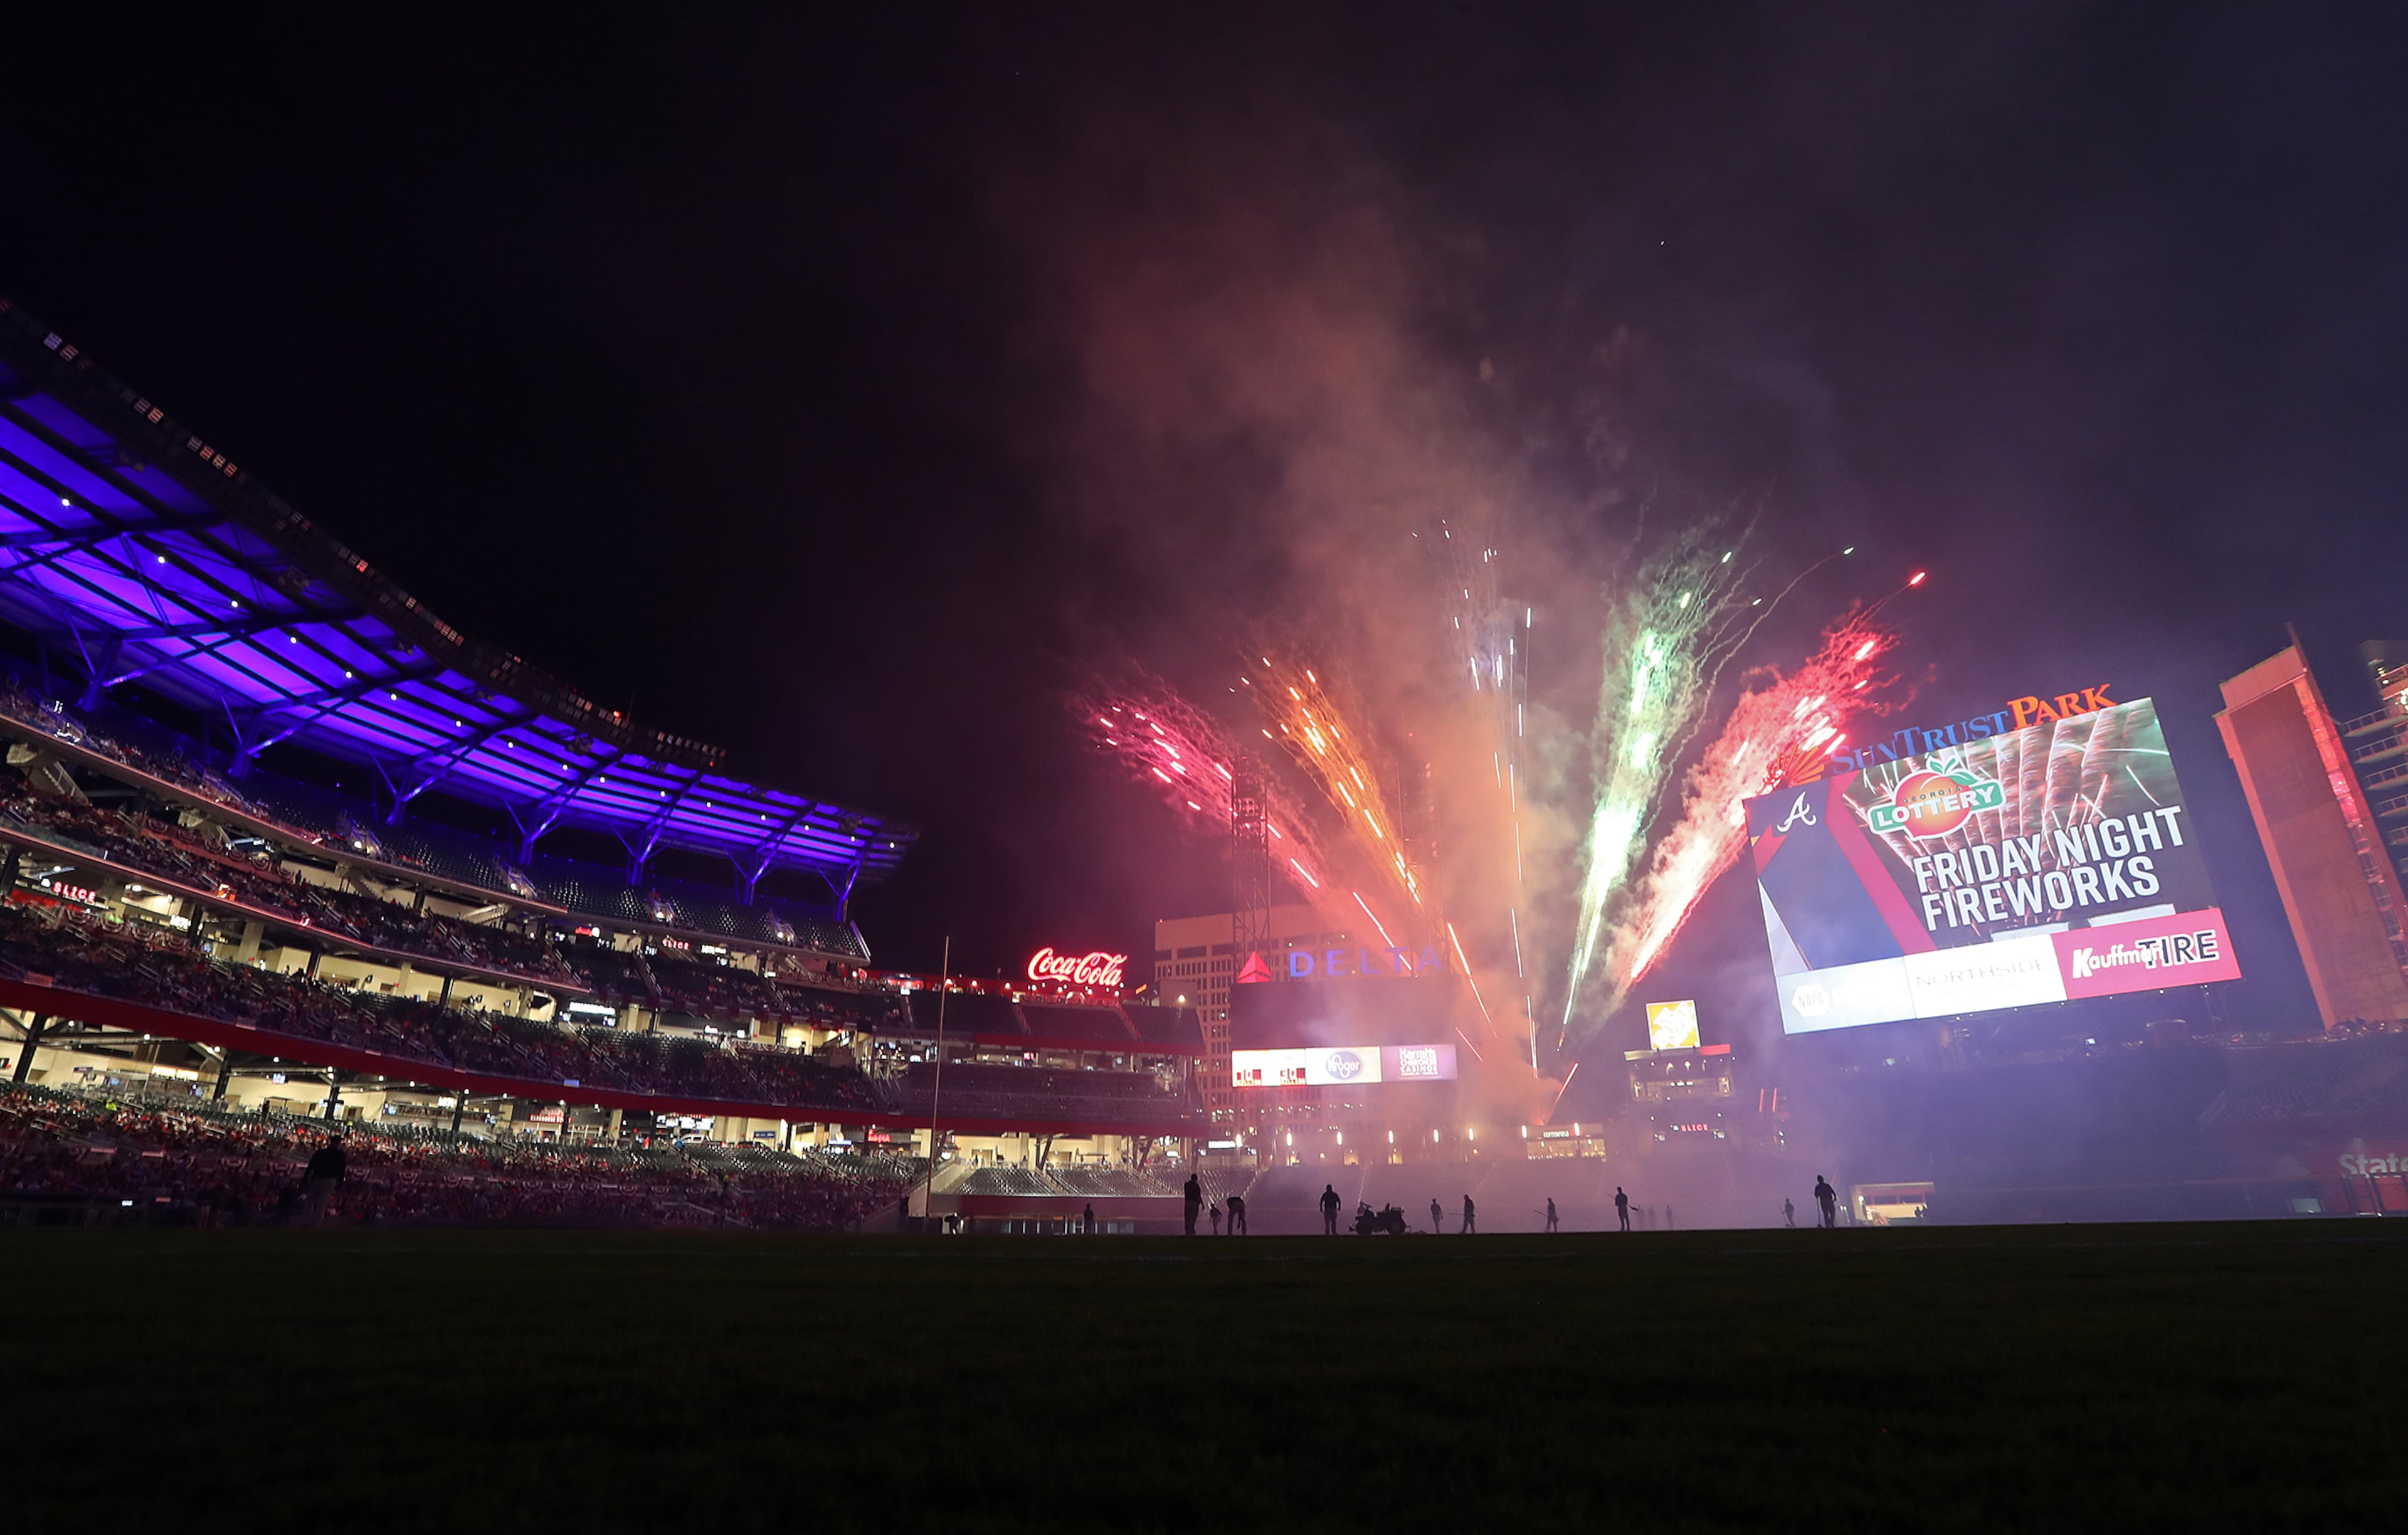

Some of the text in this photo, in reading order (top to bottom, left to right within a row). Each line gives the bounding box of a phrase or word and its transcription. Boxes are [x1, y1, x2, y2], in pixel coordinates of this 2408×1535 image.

[1876, 786, 1995, 826] LOTTERY
[1902, 786, 1962, 803] GEORGIA
[1913, 805, 2184, 894] FRIDAY NIGHT
[53, 881, 97, 904] SLICE
[1921, 855, 2161, 932] FIREWORKS
[1028, 947, 1127, 986] Coca-Cola
[1289, 945, 1443, 978] DELTA
[2072, 929, 2221, 979] Kauffman TIRE
[1916, 957, 2051, 988] NORTHSIDE
[1328, 1053, 1361, 1079] Kroger
